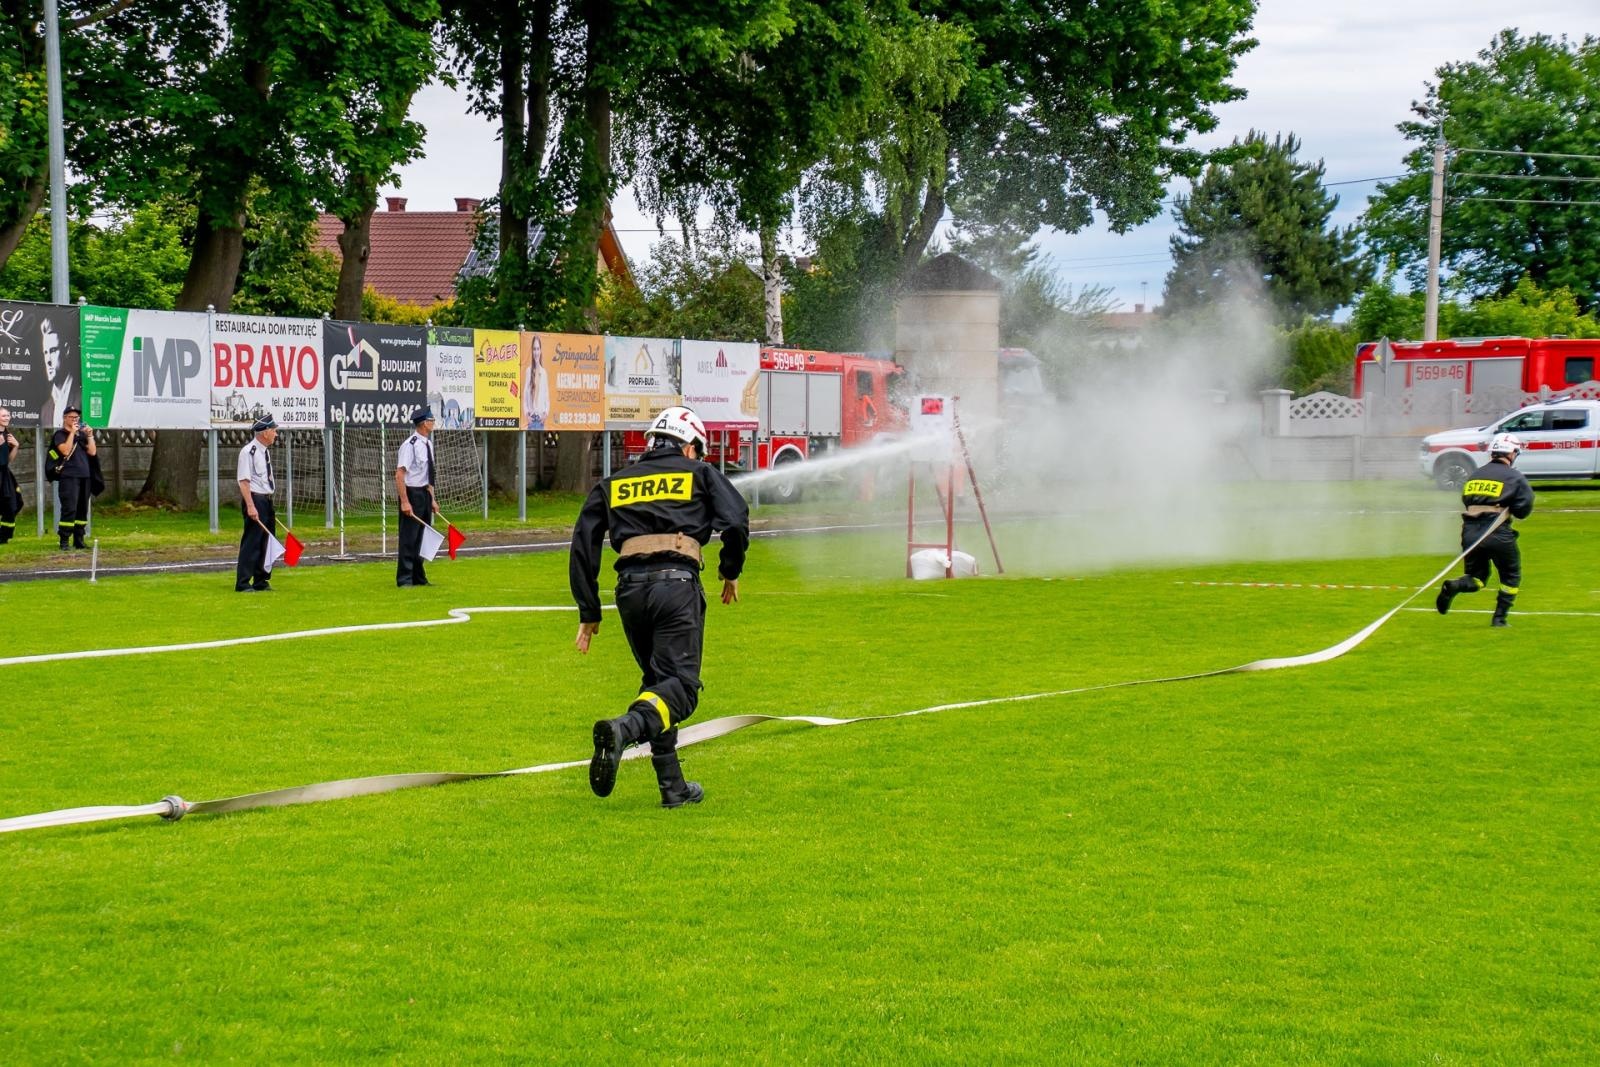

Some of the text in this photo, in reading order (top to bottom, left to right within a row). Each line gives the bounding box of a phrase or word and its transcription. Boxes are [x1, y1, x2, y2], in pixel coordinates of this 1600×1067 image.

[215, 320, 317, 338] RESTAURACJA DOM PRZYJĘĆ
[439, 352, 463, 365] Sala do
[486, 343, 519, 364] BAGER
[213, 343, 319, 390] BRAVO
[381, 359, 422, 373] BUDUJEMY
[381, 379, 422, 392] OD A DO Z
[628, 377, 654, 386] PROFI-BUD
[272, 397, 319, 408] tel. 602 744 173
[295, 412, 307, 422] 270
[330, 401, 350, 423] tel.
[351, 403, 375, 424] 665
[376, 403, 400, 424] 092
